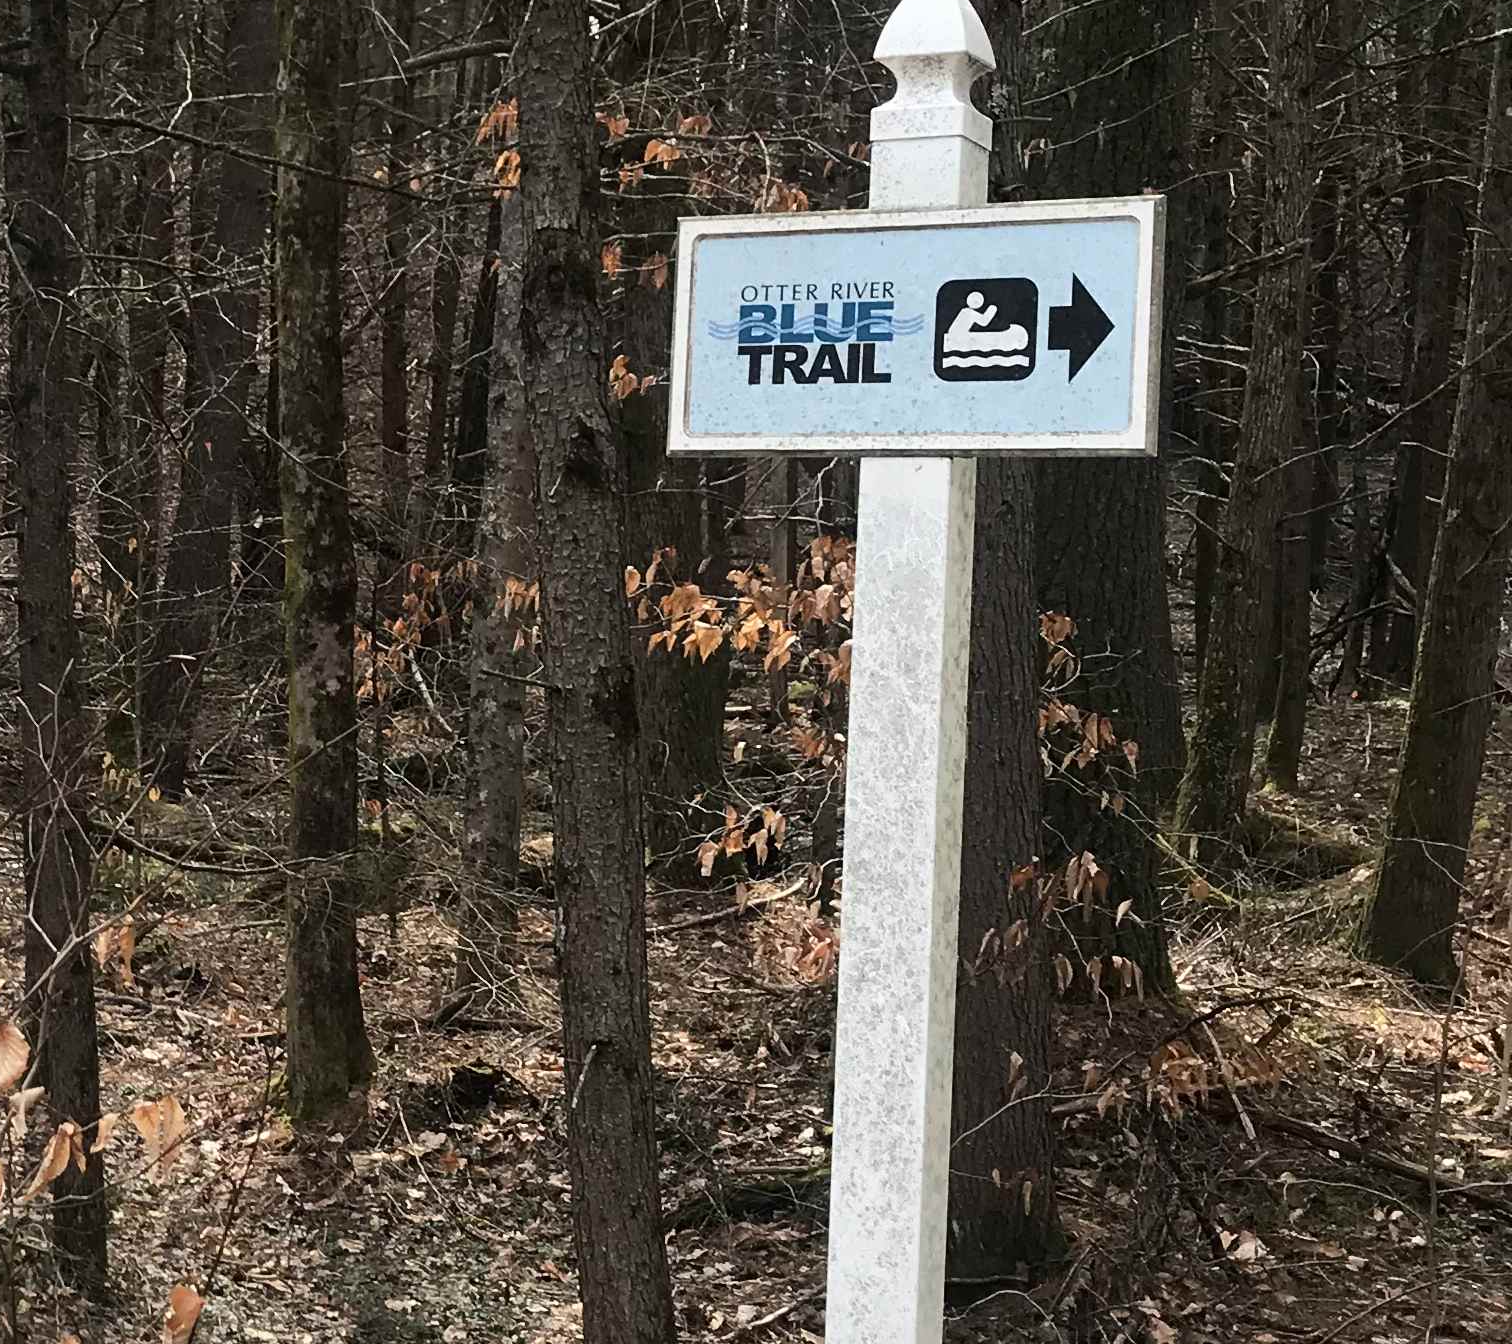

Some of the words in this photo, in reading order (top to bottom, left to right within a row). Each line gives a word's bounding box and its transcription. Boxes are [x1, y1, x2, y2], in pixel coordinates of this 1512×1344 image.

[740, 284, 818, 303] OTTER
[831, 281, 894, 299] RIVER
[738, 301, 894, 344] BLUE
[737, 343, 892, 385] TRAIL
